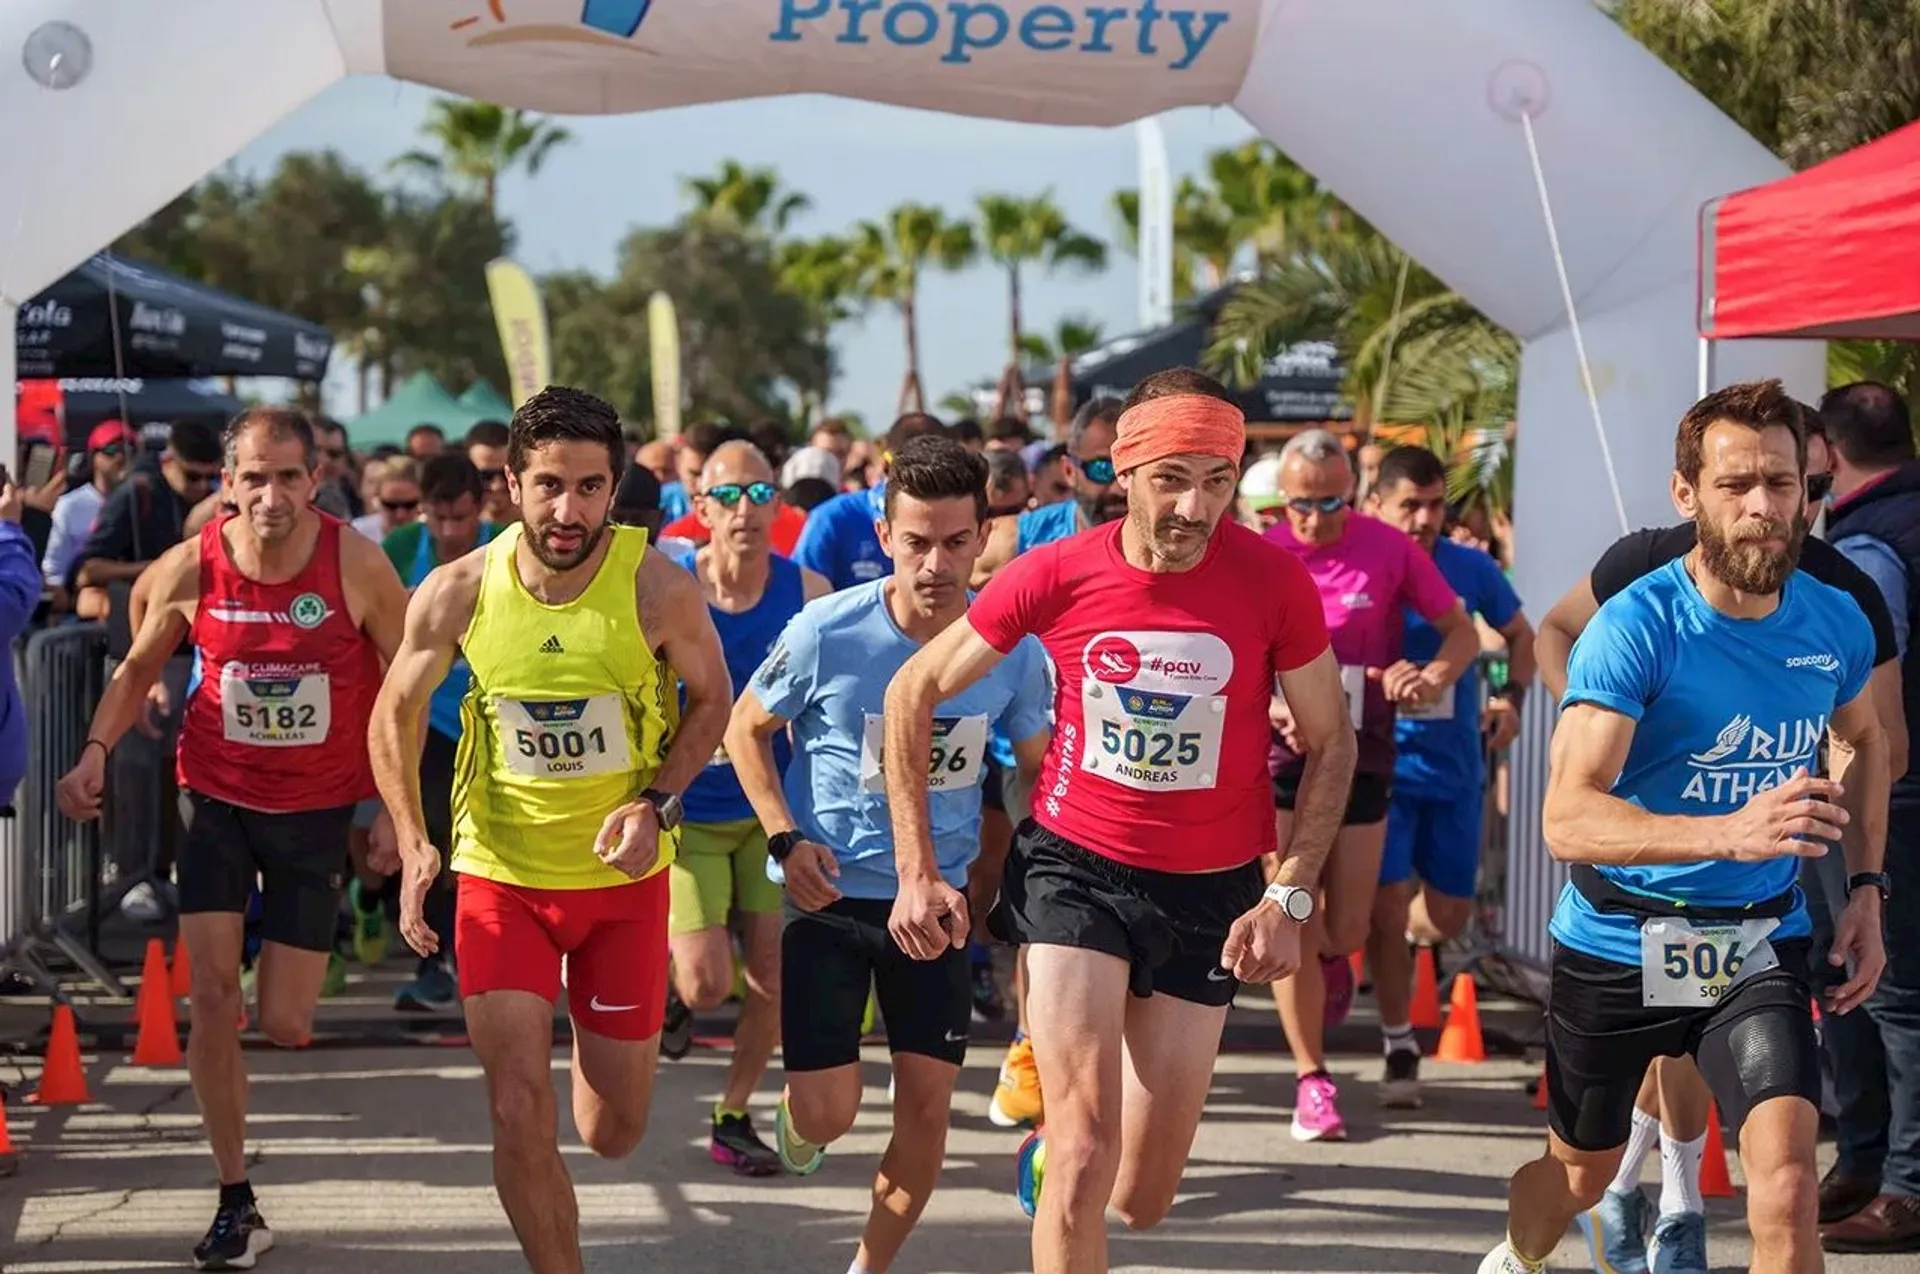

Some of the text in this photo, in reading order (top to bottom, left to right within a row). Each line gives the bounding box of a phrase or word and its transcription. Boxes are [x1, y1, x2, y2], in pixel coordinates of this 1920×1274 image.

[769, 0, 1229, 69] Property
[1150, 656, 1202, 675] #pav
[1786, 653, 1833, 669] saucony
[236, 704, 317, 729] 5182
[249, 732, 305, 741] ACHILLEAS
[516, 727, 607, 759] 5001
[1102, 720, 1201, 767] 5025
[1749, 714, 1825, 760] RUN
[547, 762, 584, 773] LOUIS
[1116, 763, 1178, 783] ANDREAS
[1681, 764, 1797, 803] ATHEN
[1664, 941, 1744, 980] 506
